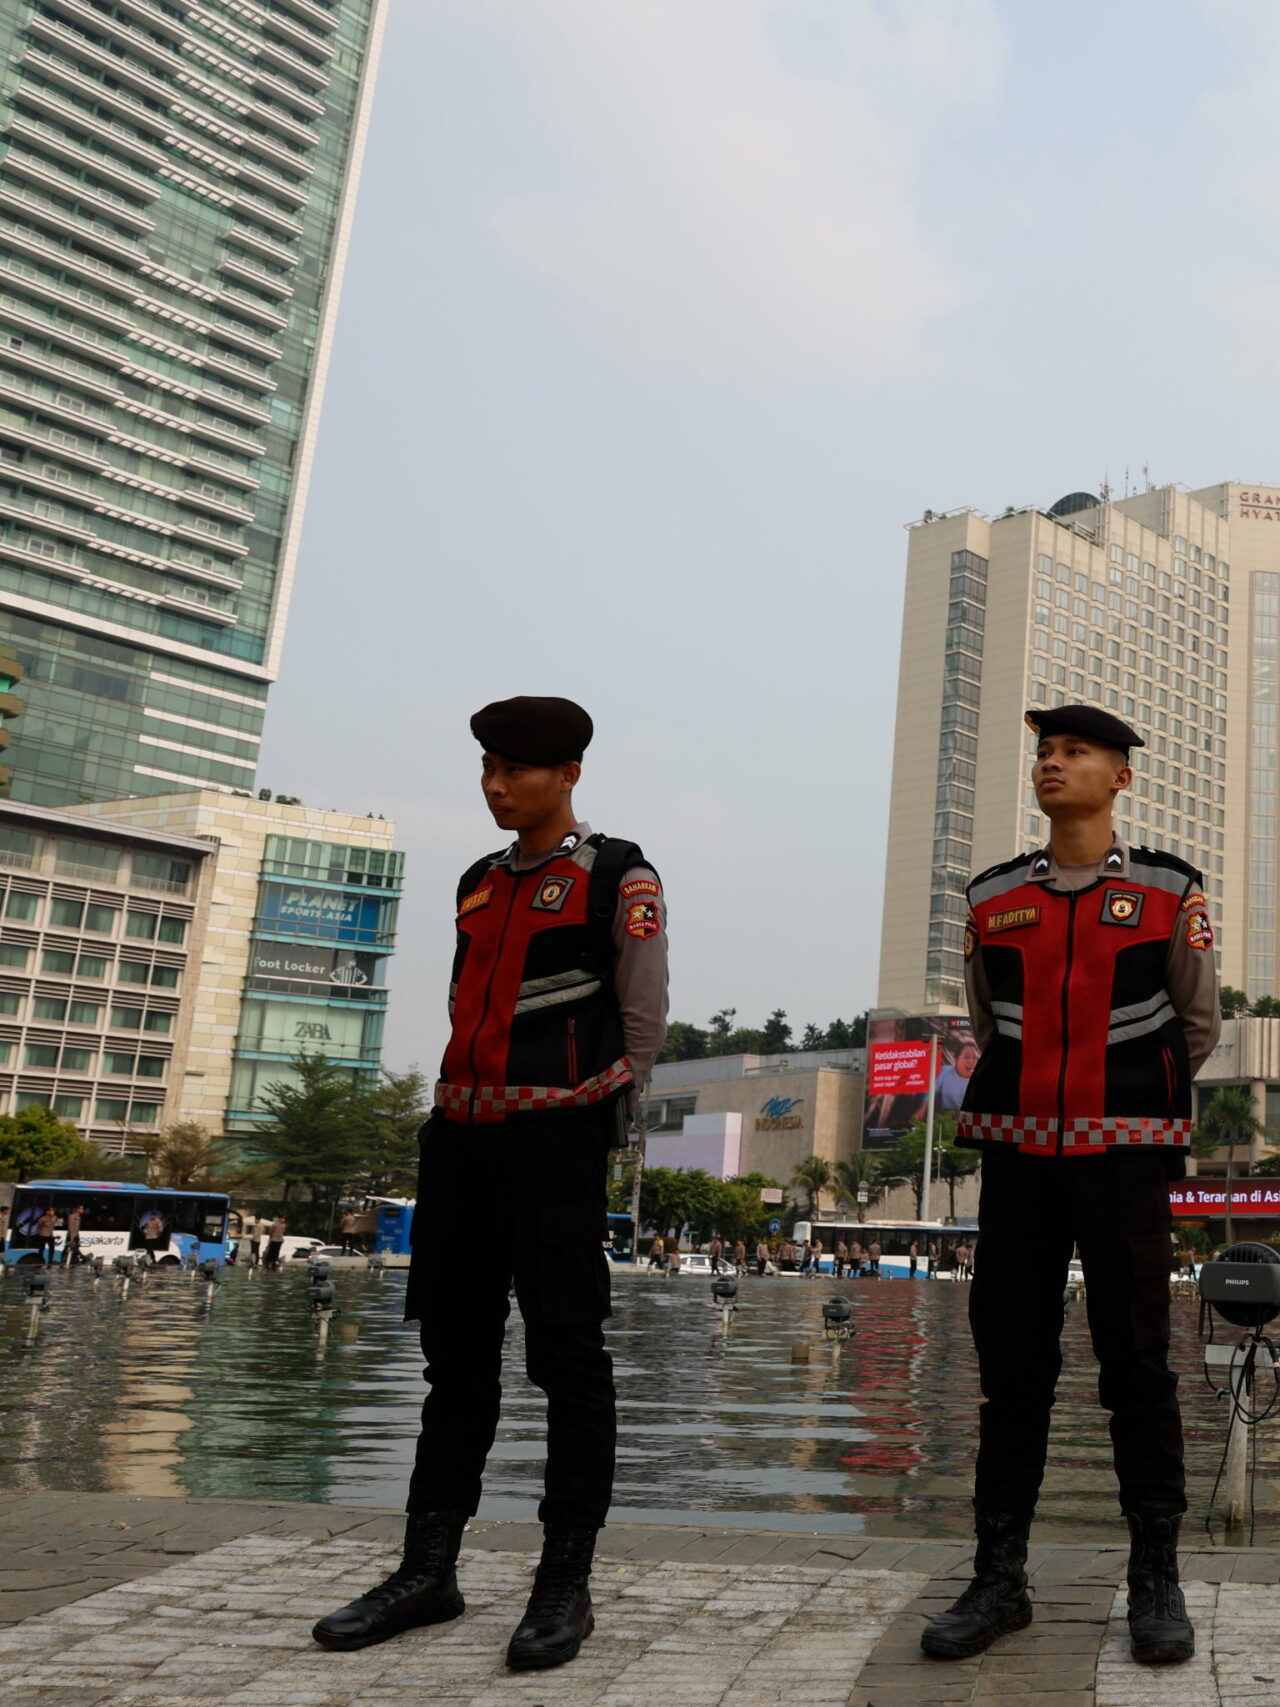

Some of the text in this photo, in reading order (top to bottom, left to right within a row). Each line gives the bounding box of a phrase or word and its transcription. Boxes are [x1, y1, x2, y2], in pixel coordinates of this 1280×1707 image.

[286, 891, 359, 912] PLANET
[280, 905, 353, 922] SPORTS.ASIA
[284, 960, 326, 974] Locker
[294, 1021, 332, 1040] ZARA
[875, 1049, 926, 1060] Ketidakstabilan
[874, 1063, 894, 1073] pasar
[755, 1115, 804, 1131] INDONESIA
[1186, 1191, 1195, 1203] &
[1250, 1190, 1261, 1203] di
